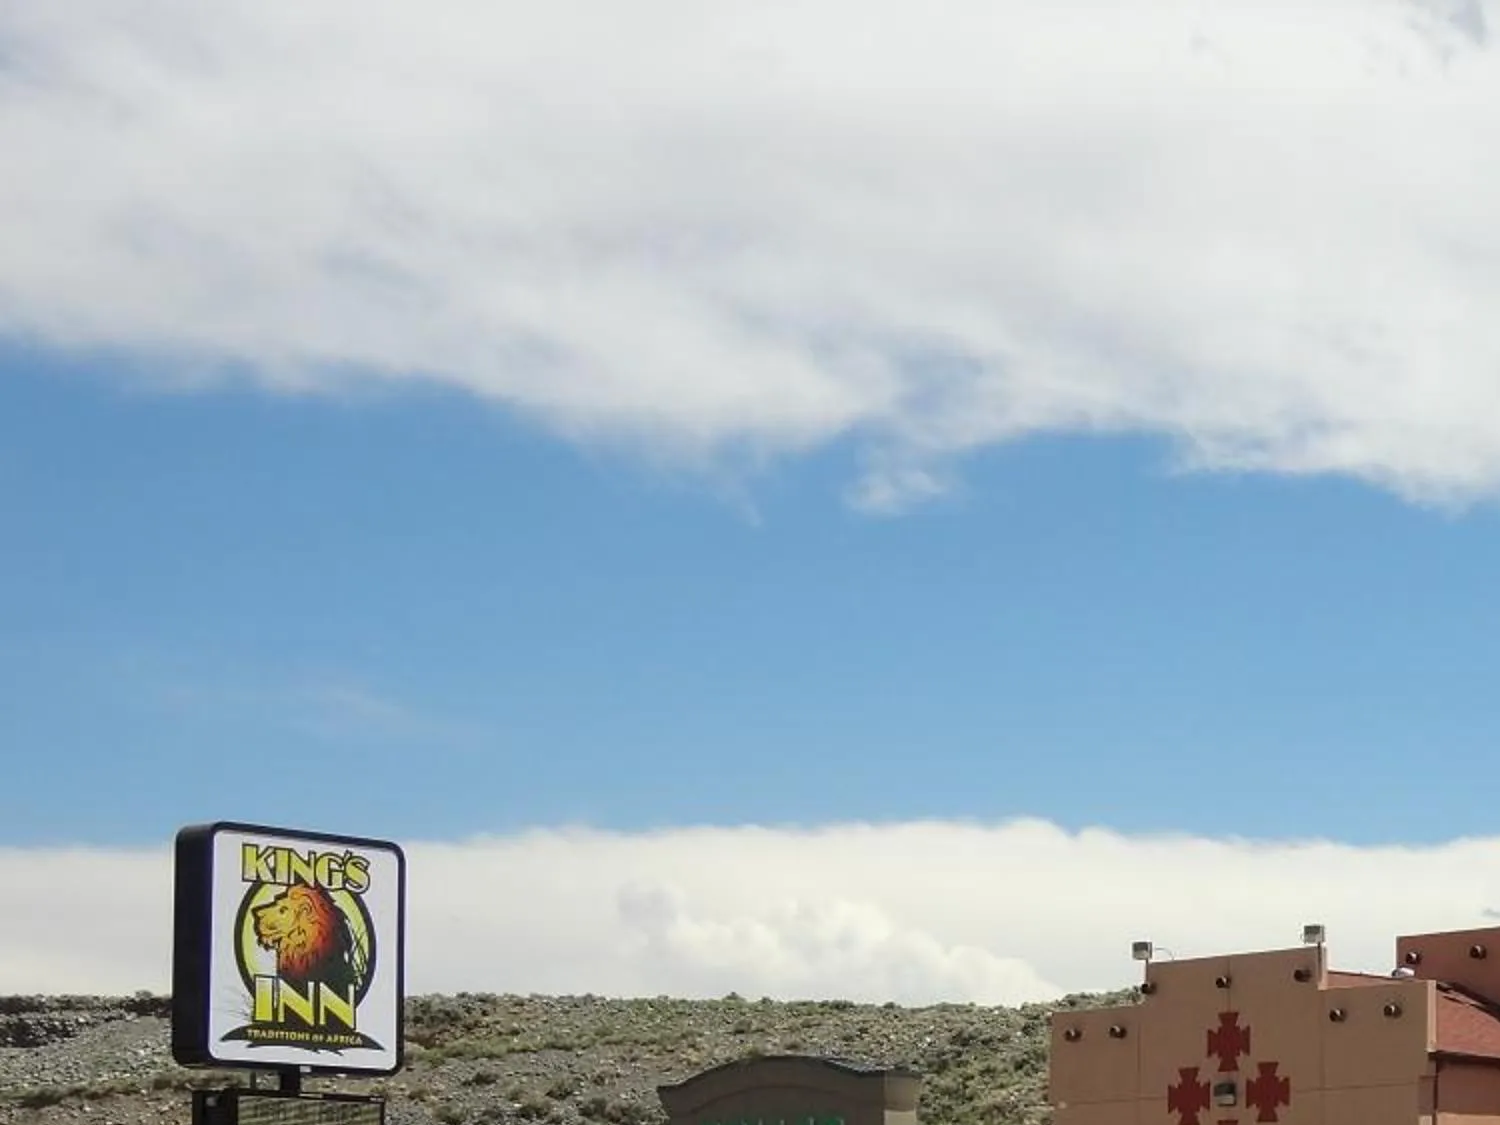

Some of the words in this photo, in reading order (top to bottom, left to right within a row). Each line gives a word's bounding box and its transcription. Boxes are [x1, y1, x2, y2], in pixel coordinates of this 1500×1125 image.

[241, 843, 371, 894] KING'S
[253, 974, 357, 1031] INN
[247, 1029, 310, 1042] TRADITIONS
[326, 1034, 363, 1046] AFRICA
